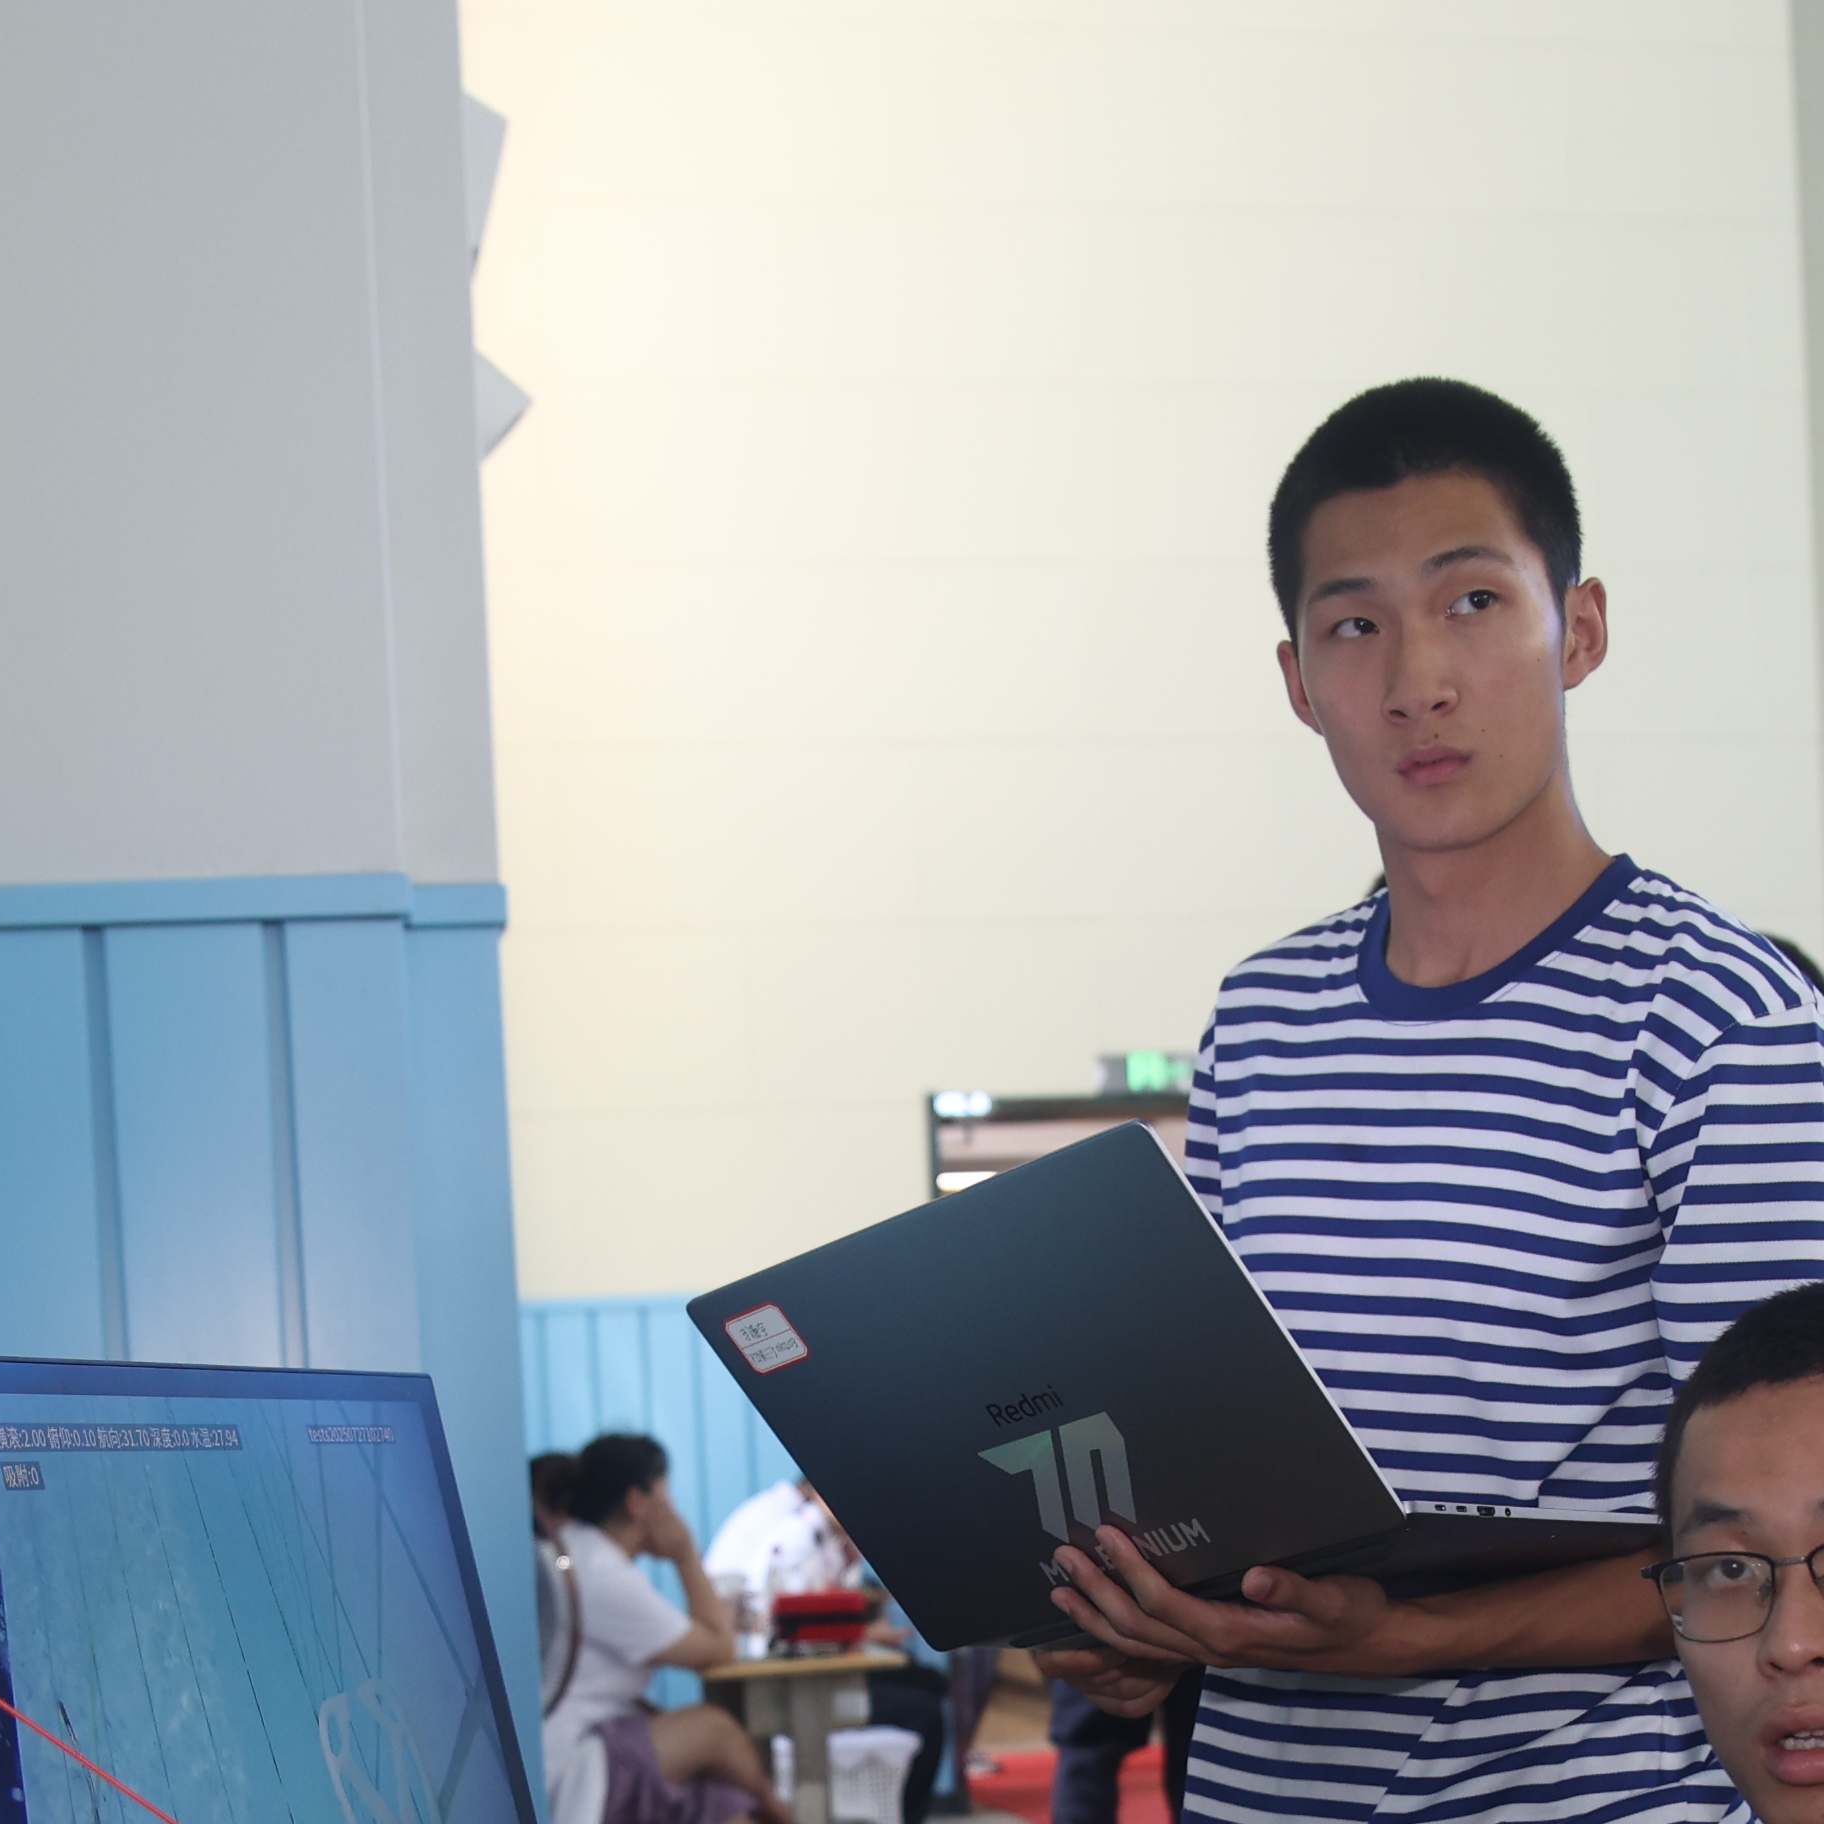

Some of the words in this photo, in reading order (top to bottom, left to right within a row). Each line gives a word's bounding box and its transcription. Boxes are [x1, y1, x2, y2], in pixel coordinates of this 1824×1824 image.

[985, 1384, 1064, 1428] Redmi
[47, 1426, 96, 1449] 俯仰:0.10
[98, 1427, 150, 1448] 航向:31.70
[151, 1427, 190, 1448] 深度:0.0
[191, 1427, 239, 1448] 水温:27.94
[3, 1464, 39, 1488] 吸附:0
